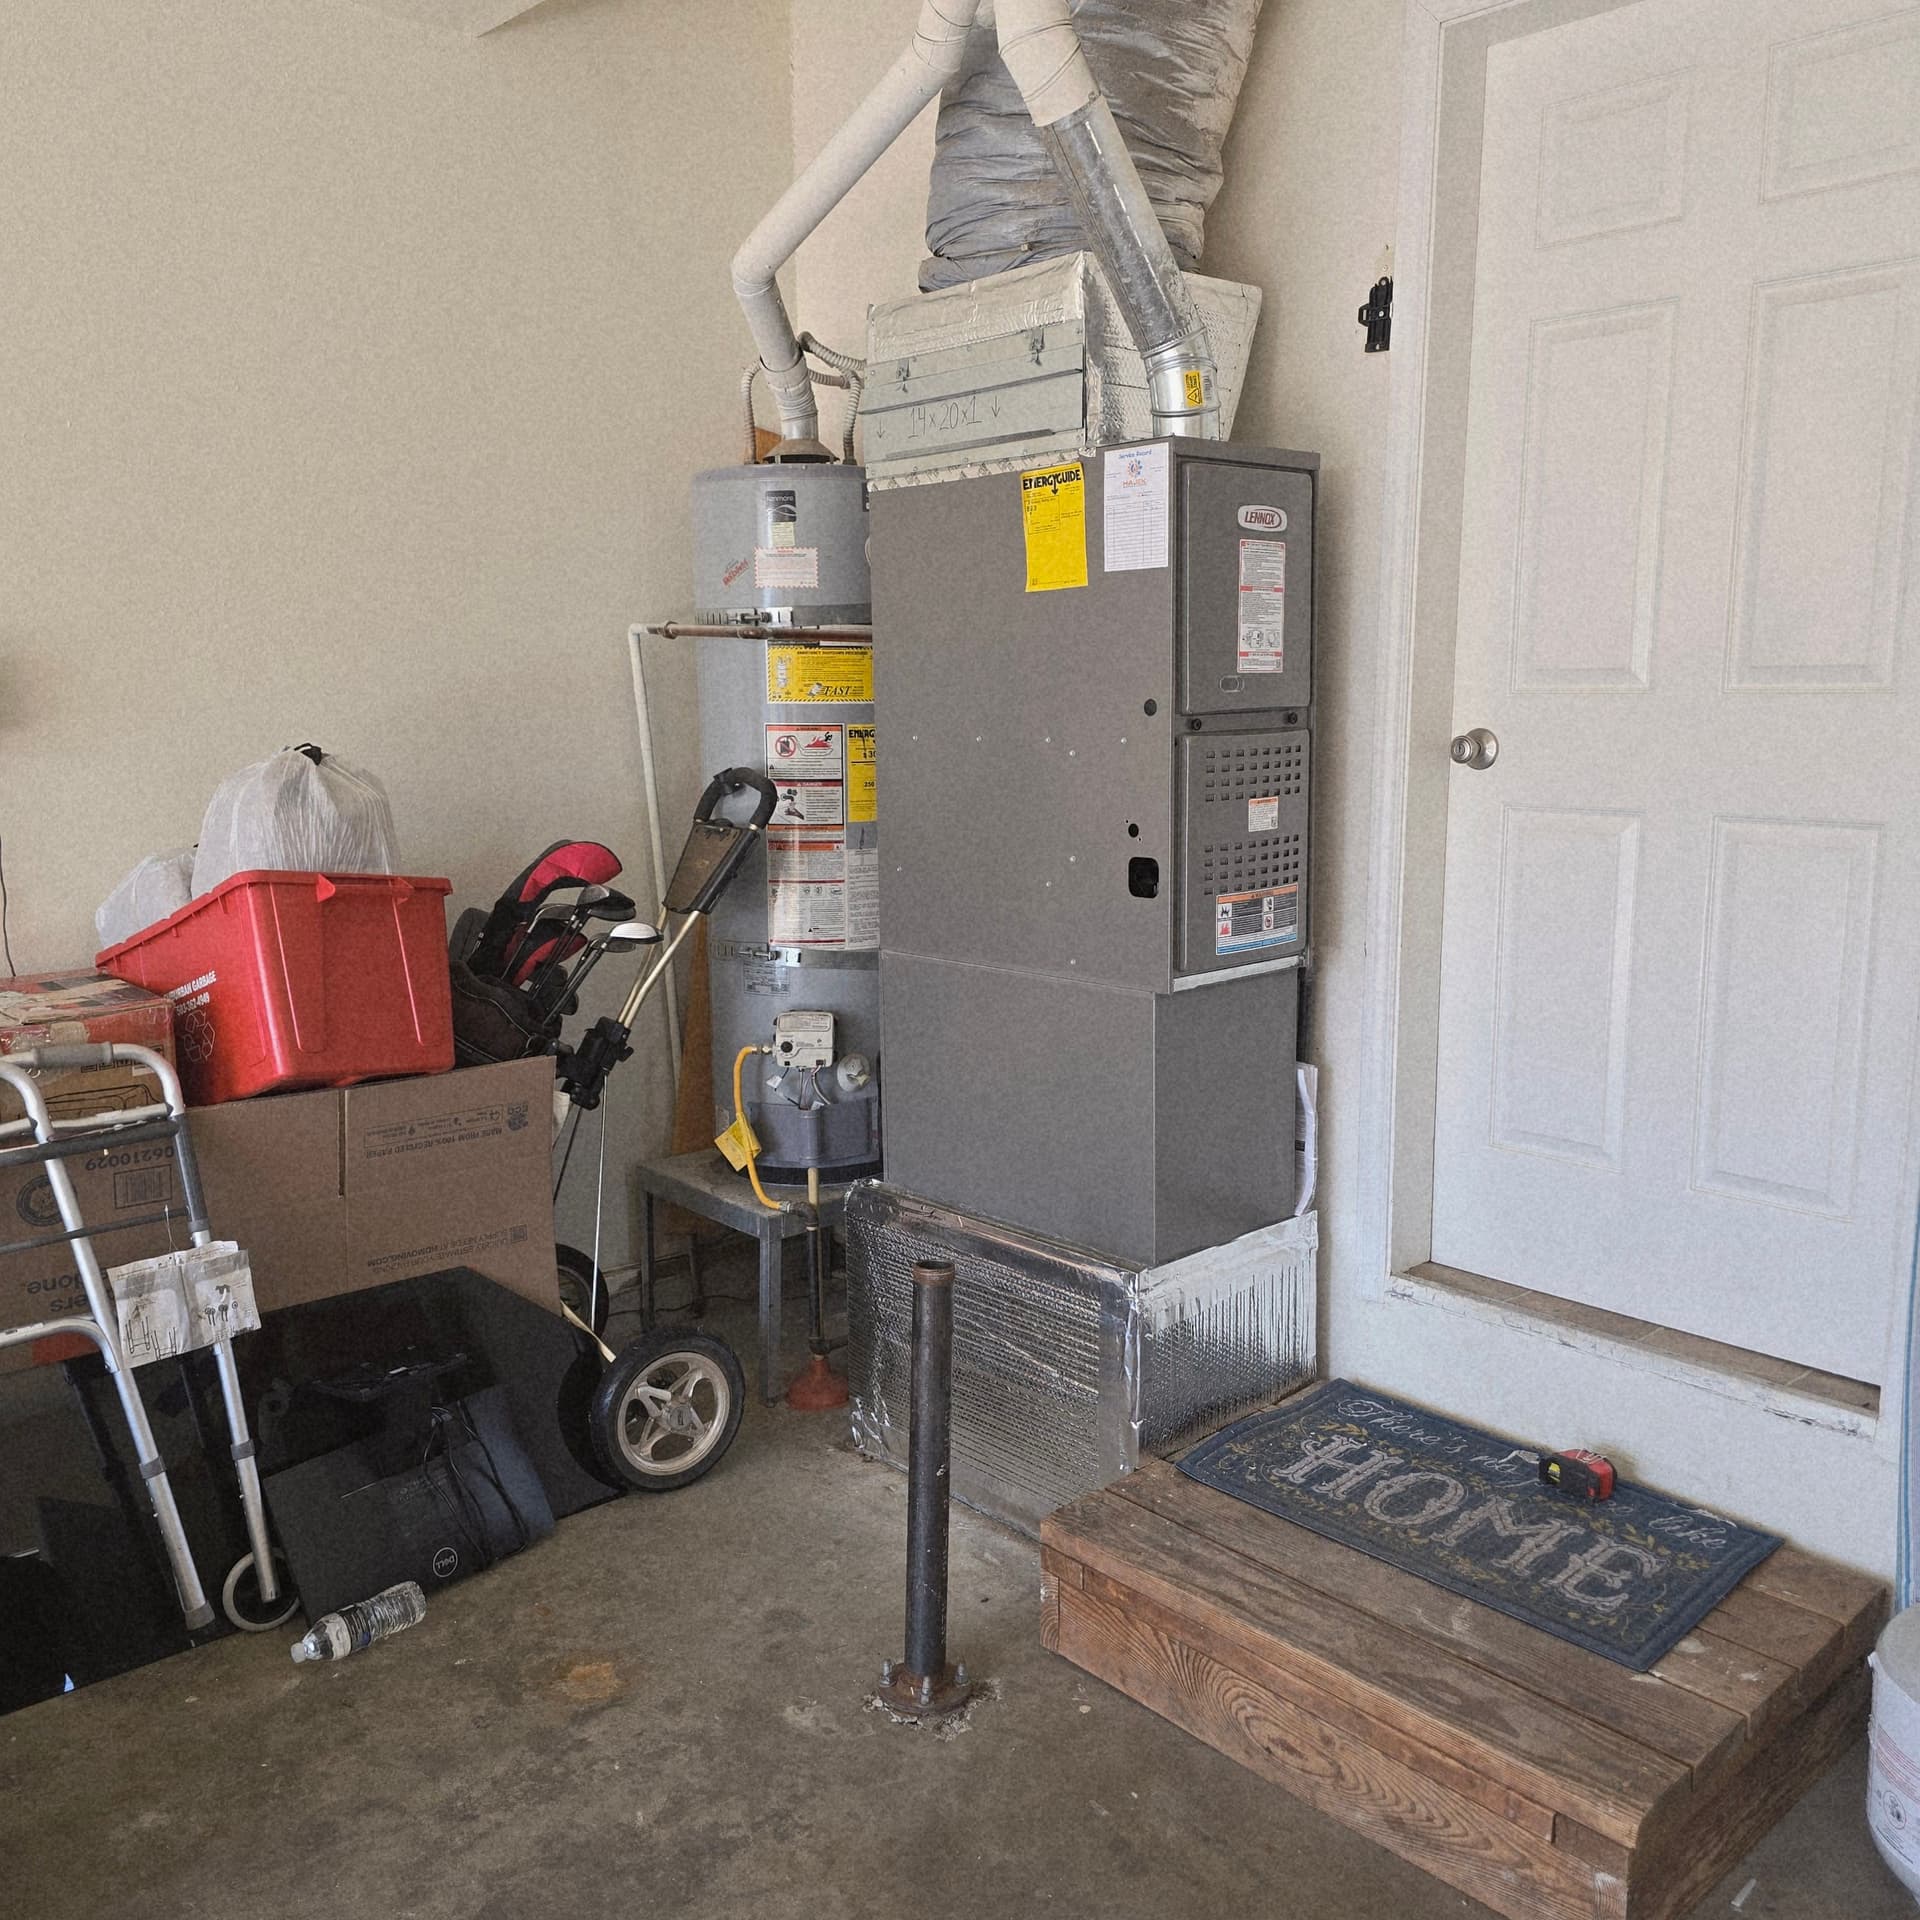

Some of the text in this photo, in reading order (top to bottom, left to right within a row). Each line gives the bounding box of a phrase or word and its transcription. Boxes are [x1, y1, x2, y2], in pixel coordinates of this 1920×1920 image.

[1244, 511, 1276, 525] LENNOX
[823, 685, 851, 696] FAST
[85, 1146, 175, 1172] 06210029
[1270, 1434, 1670, 1613] HOME
